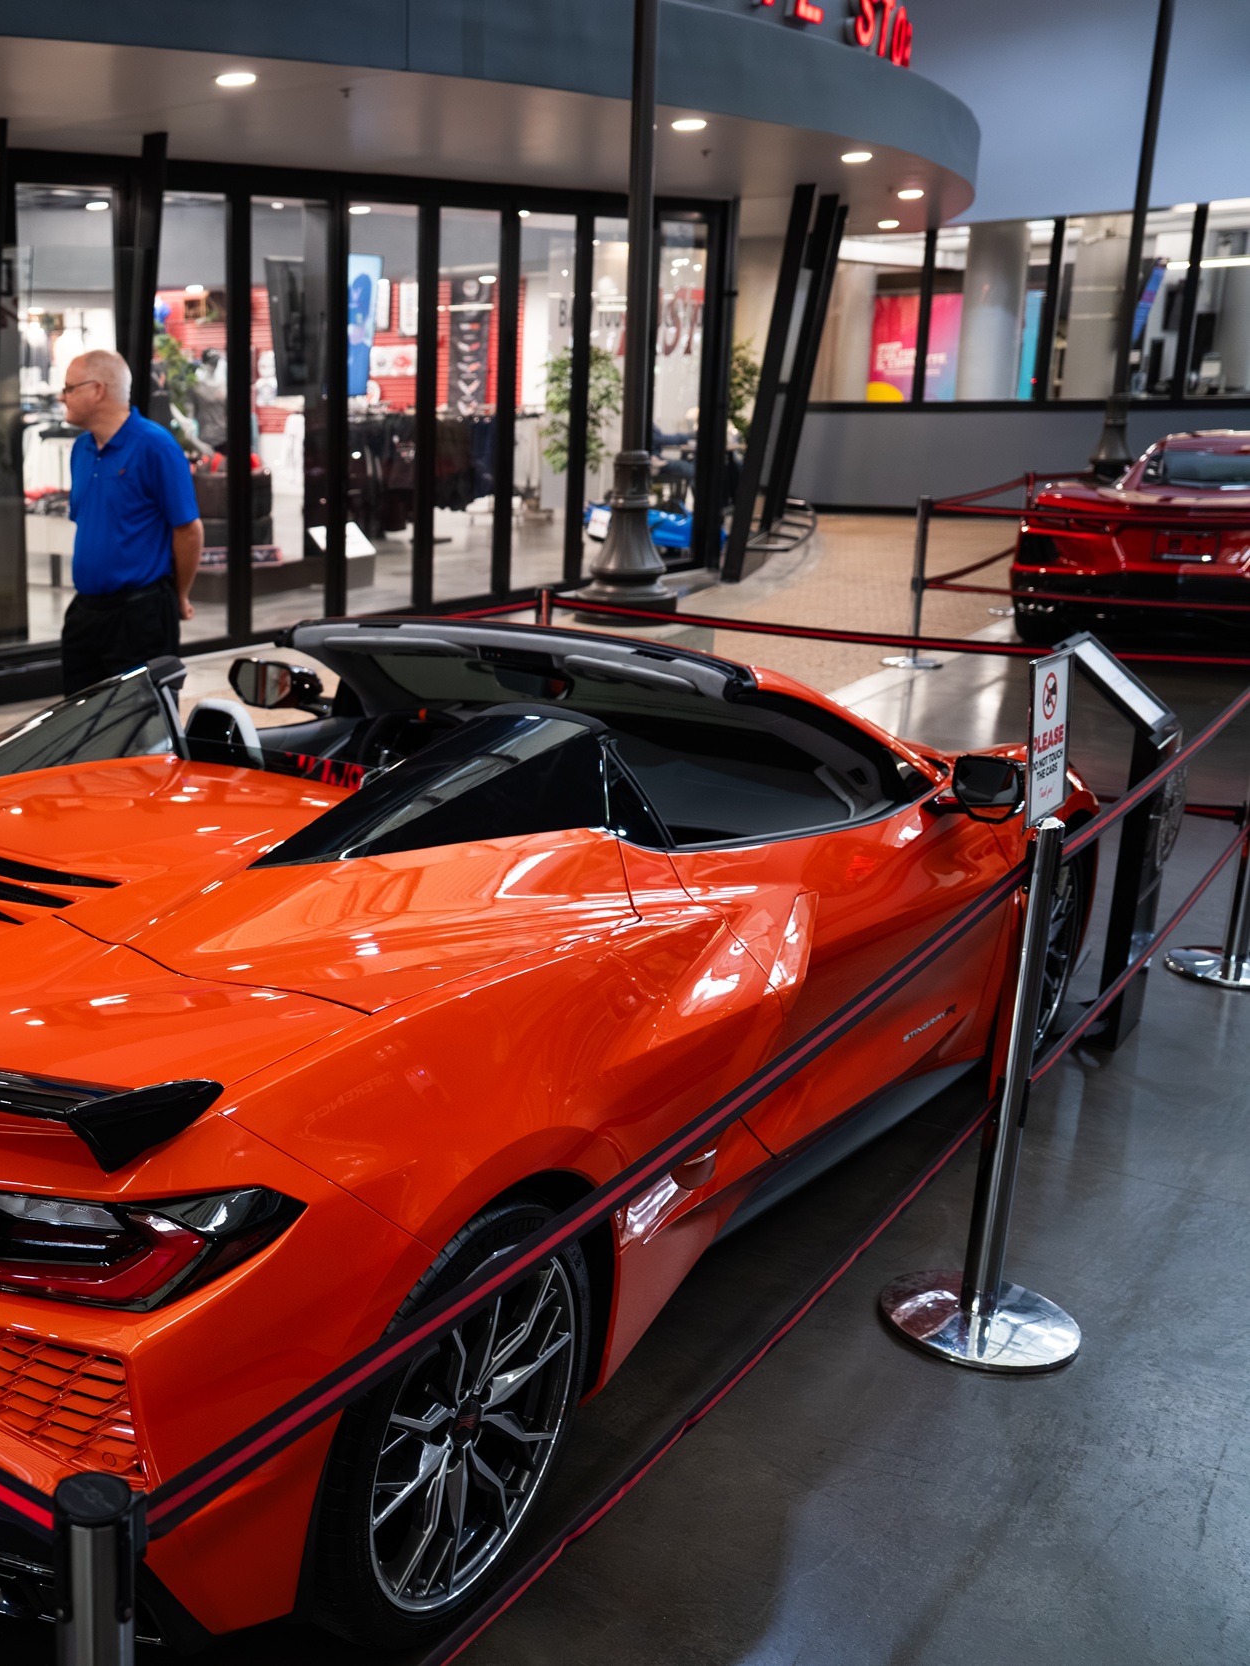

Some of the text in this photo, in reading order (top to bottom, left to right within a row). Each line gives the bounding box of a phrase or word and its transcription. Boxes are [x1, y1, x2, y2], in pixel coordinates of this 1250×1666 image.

[1038, 753, 1049, 769] NOT
[1048, 748, 1063, 766] TOUCH
[1036, 762, 1058, 781] THE CARS
[903, 1010, 945, 1043] STINGRAY
